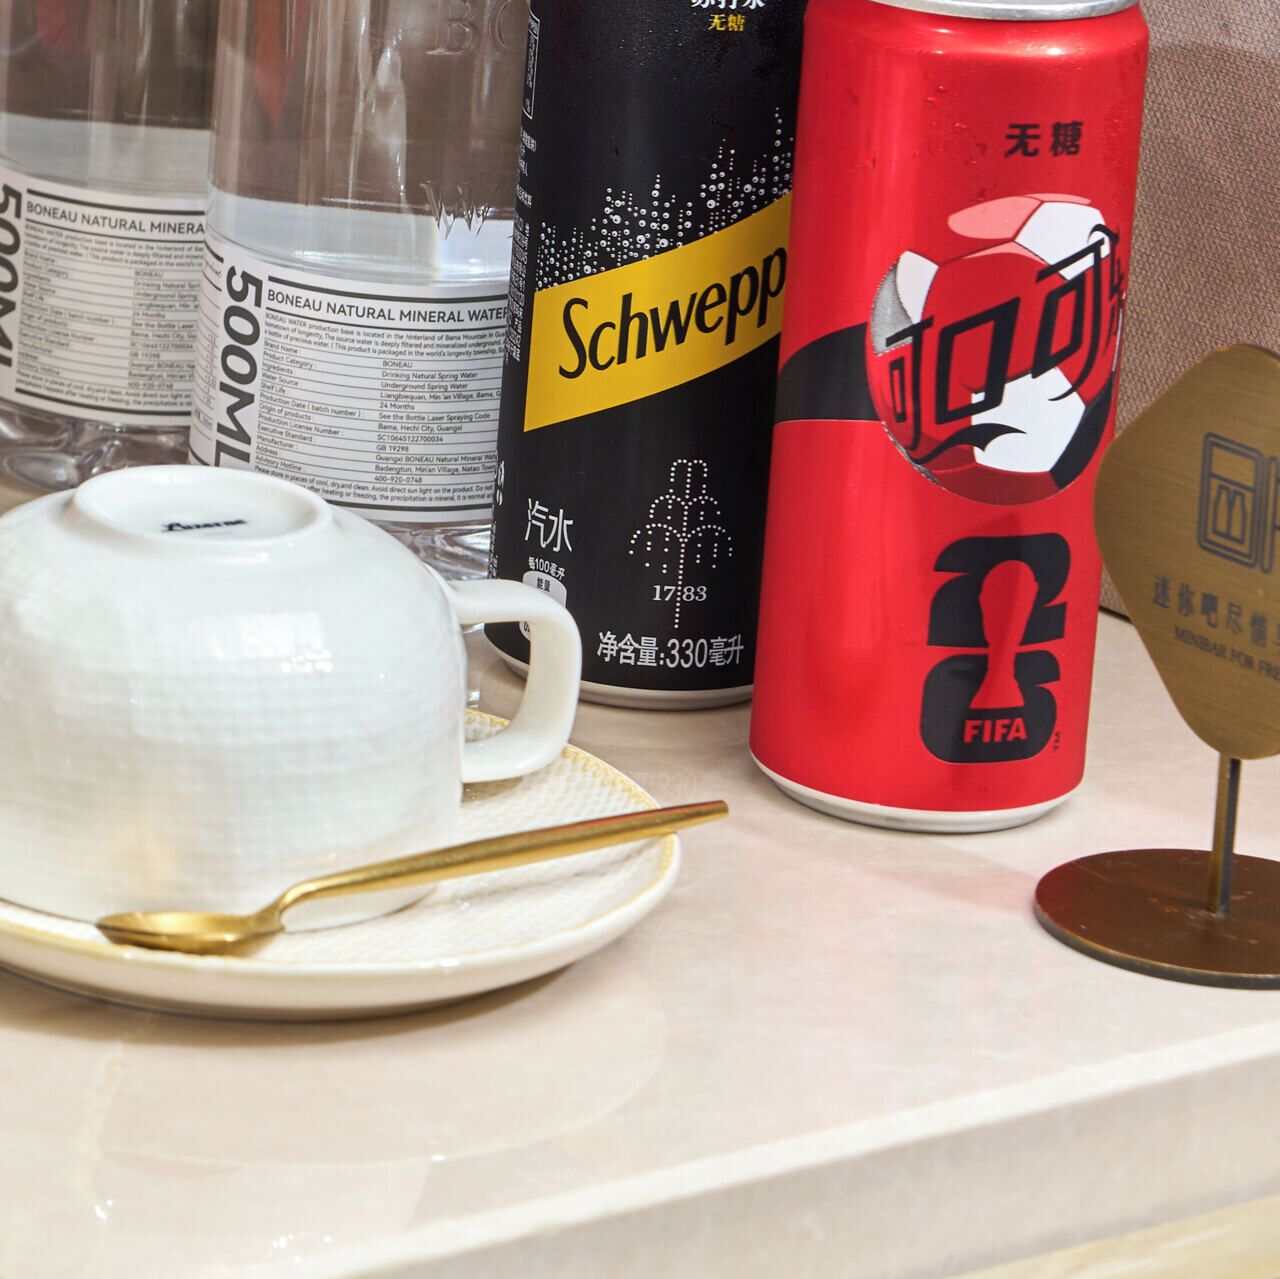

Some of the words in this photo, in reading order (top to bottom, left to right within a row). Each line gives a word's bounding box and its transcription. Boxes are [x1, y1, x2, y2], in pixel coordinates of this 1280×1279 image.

[707, 13, 746, 32] 无糖
[1004, 120, 1084, 158] 无糖
[26, 200, 77, 223] BONEAU
[80, 214, 146, 234] NATURAL
[149, 221, 205, 235] MINERA
[267, 288, 322, 312] BONEAU
[326, 303, 395, 321] NATURAL
[399, 309, 464, 323] MINERAL
[558, 247, 788, 379] Schwepp
[340, 328, 354, 336] base
[394, 332, 404, 340] the
[406, 333, 435, 341] hinterland
[356, 338, 373, 346] water
[335, 342, 346, 351] This
[347, 344, 371, 354] product
[415, 349, 425, 357] the
[213, 265, 263, 468] 500ML
[382, 360, 413, 369] BONEAU
[381, 371, 410, 380] Drinking
[438, 372, 459, 380] Spring
[460, 371, 478, 379] Water
[381, 381, 426, 391] Underground
[427, 382, 449, 392] Spring
[449, 382, 468, 390] Water
[379, 401, 388, 409] 24
[390, 402, 415, 411] Months
[379, 412, 391, 420] See
[405, 413, 425, 421] Bottle
[427, 414, 445, 422] Laser
[446, 412, 473, 422] Spraying
[474, 411, 491, 420] Code
[436, 424, 463, 433] Guangxi
[389, 444, 409, 452] 19298
[375, 454, 403, 464] Guangxi
[404, 455, 435, 463] BONEAU
[436, 455, 460, 463] Natural
[460, 454, 483, 462] Mineral
[321, 487, 344, 498] heating
[390, 494, 427, 502] precipitation
[371, 485, 388, 493] Avoid
[389, 485, 406, 494] direct
[419, 486, 432, 495] light
[441, 486, 451, 494] the
[524, 497, 574, 553] 汽水
[596, 630, 745, 669] 净含量:330毫升
[963, 717, 1028, 744] FIFA
